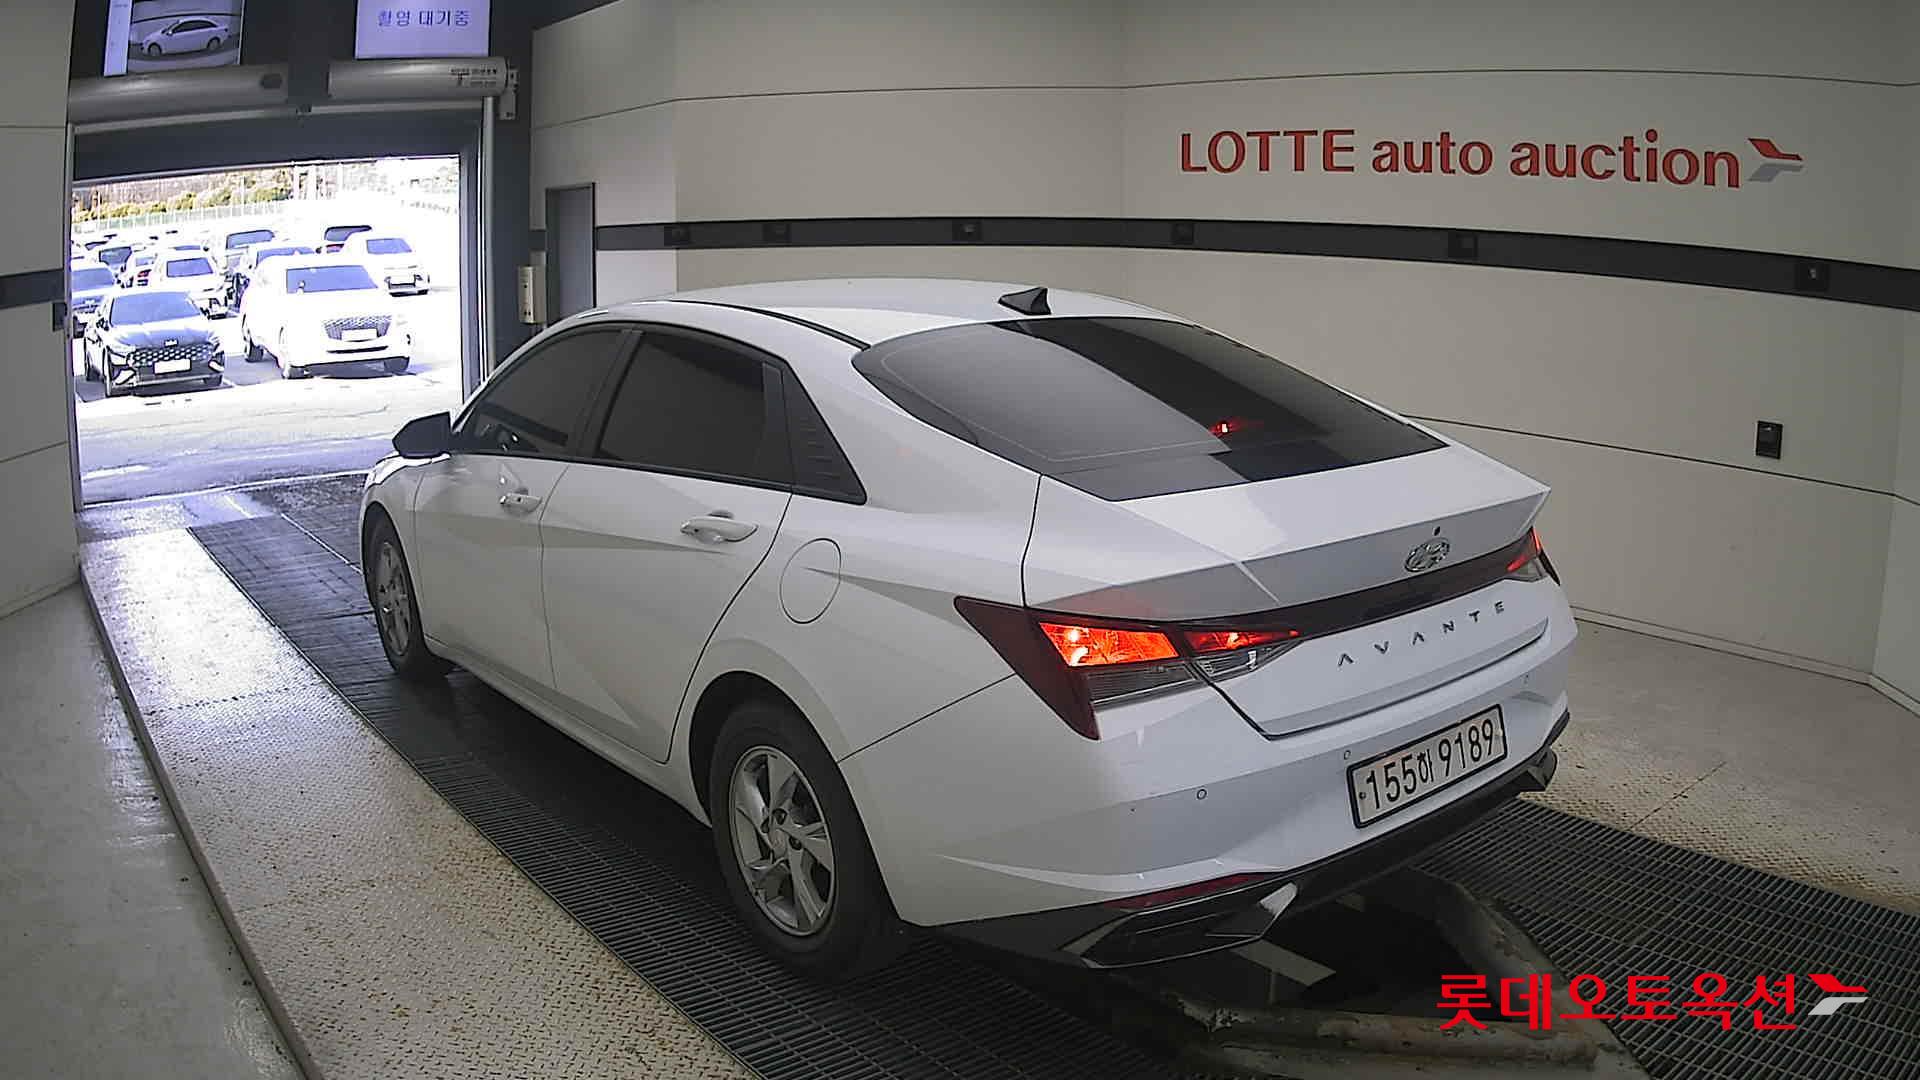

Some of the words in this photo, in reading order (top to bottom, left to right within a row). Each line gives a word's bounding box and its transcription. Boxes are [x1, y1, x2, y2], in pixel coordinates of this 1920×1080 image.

[378, 9, 410, 27] 촬영
[418, 10, 470, 27] 대기중
[1181, 129, 1355, 173] LOTTE
[1371, 131, 1494, 175] auto
[1509, 128, 1740, 189] auction
[1337, 601, 1505, 668] AVANTE
[1438, 718, 1494, 777] 9189
